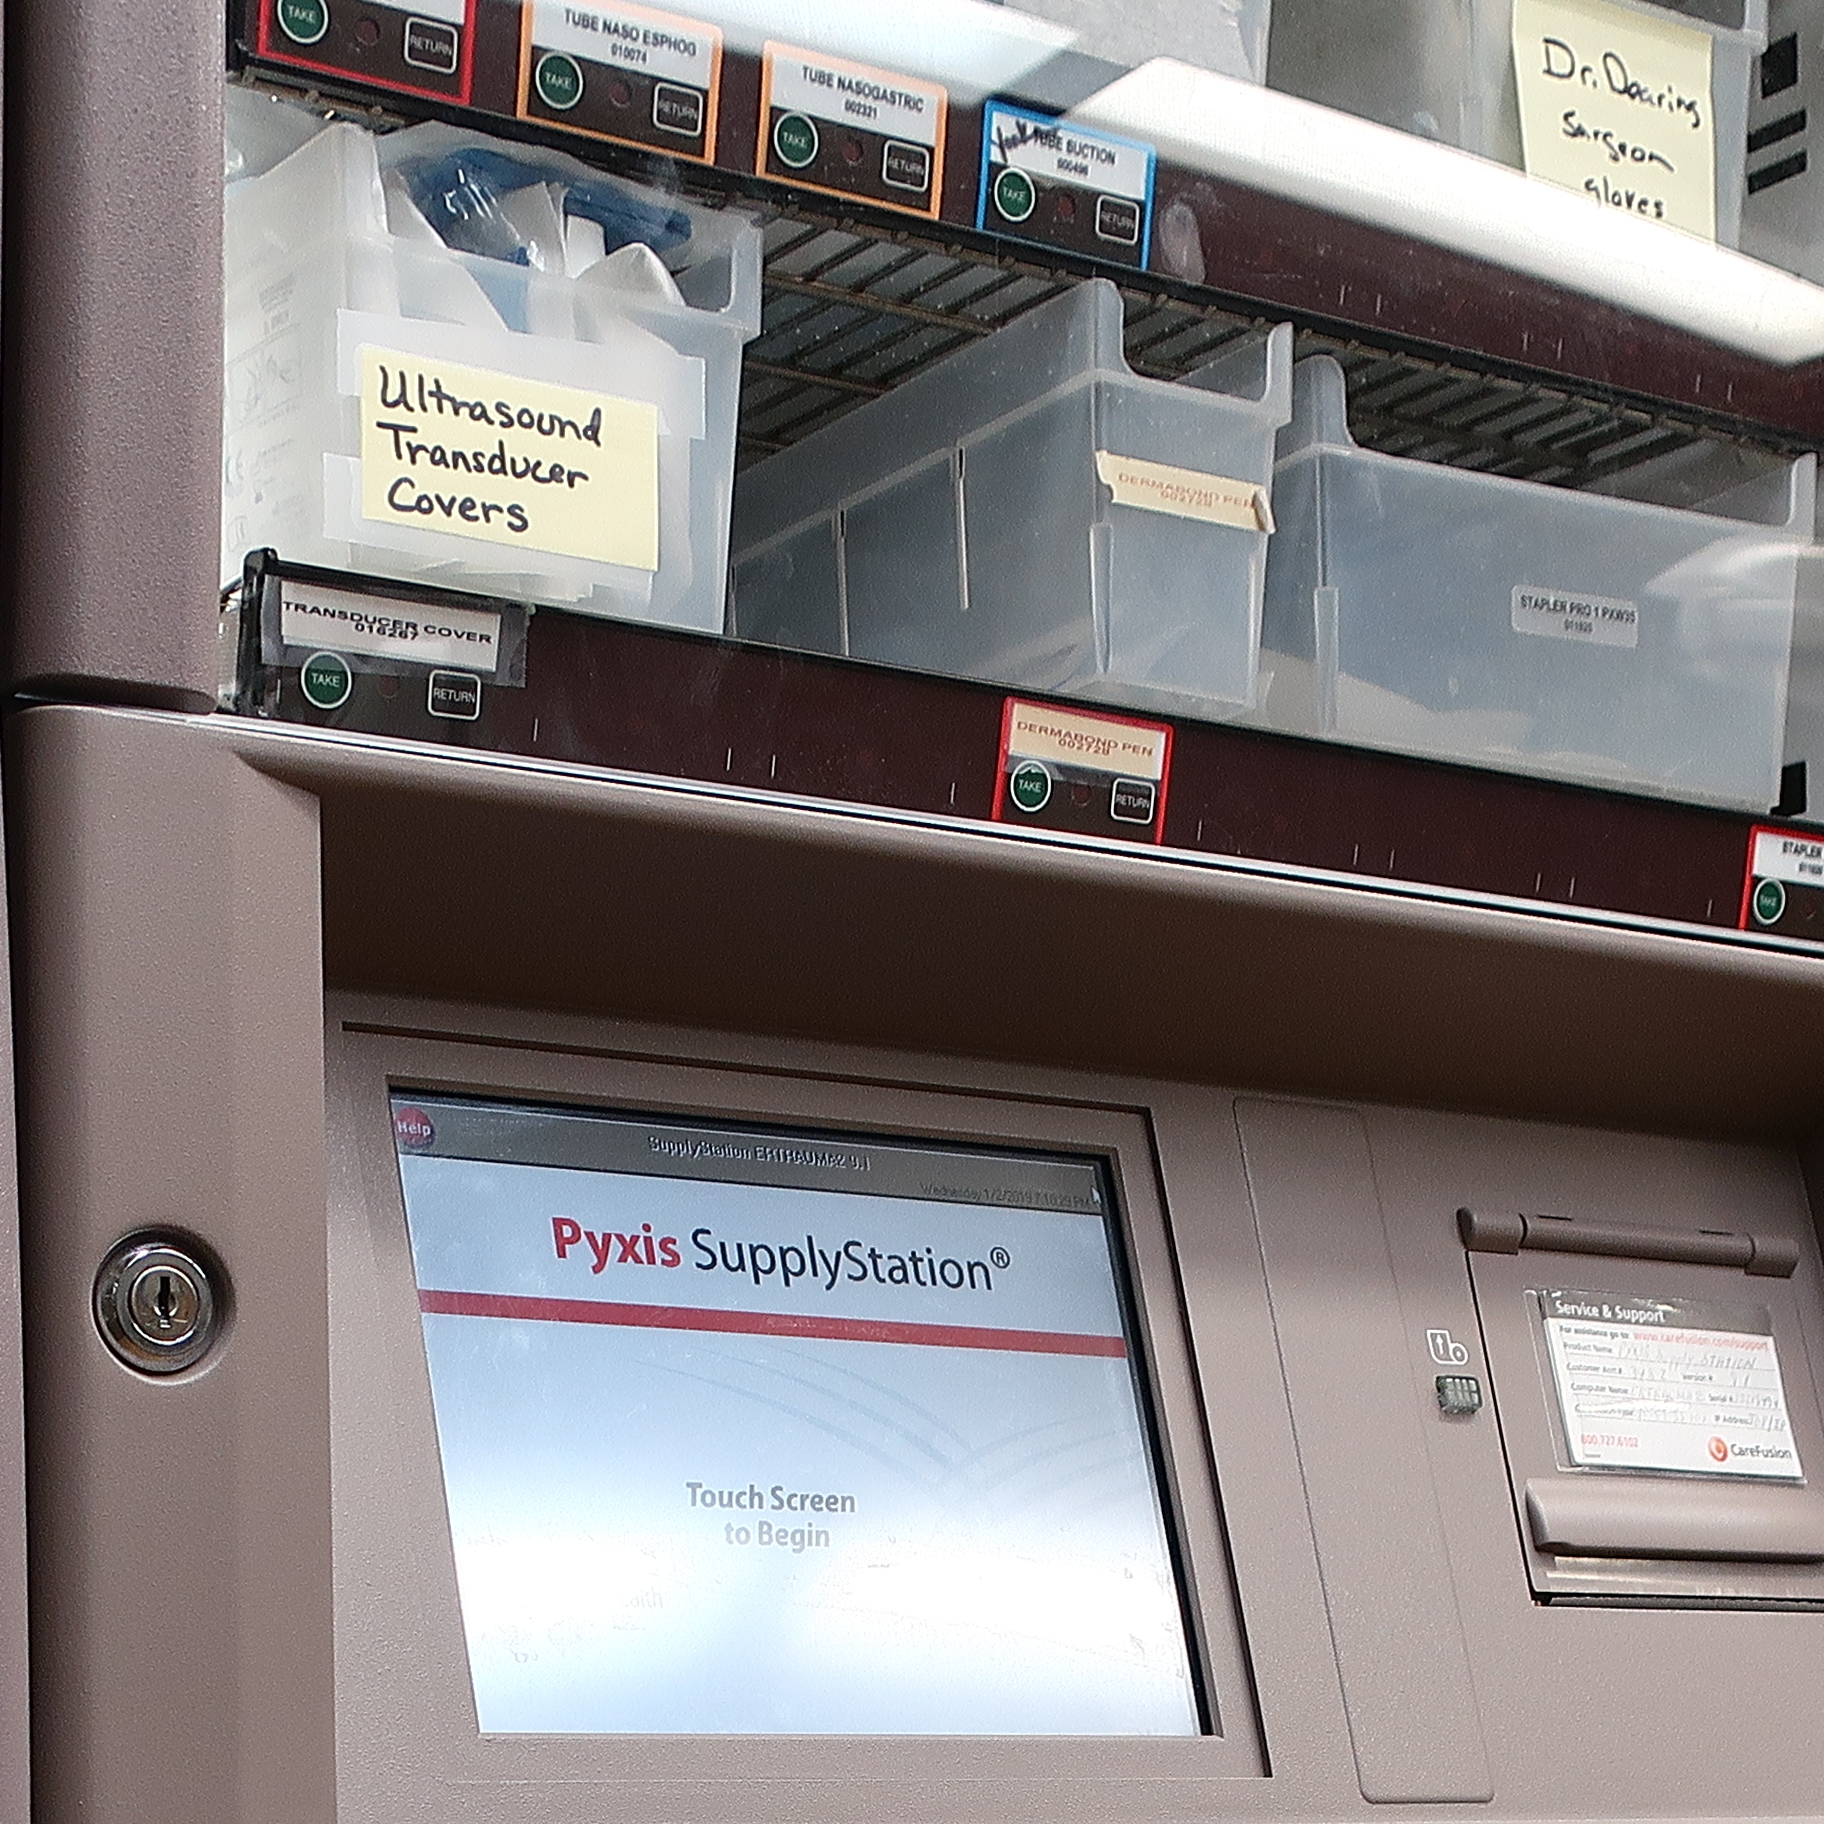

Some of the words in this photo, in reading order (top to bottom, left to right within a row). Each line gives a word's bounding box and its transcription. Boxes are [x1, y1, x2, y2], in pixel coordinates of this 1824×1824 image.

[564, 9, 599, 32] TUBE
[602, 19, 639, 43] NASO
[643, 29, 697, 57] ESPHOG
[1543, 37, 1598, 89] Dr.
[543, 71, 573, 91] TAKE
[801, 65, 834, 89] TUBE
[836, 76, 924, 113] NASOGASTRIC
[1066, 136, 1116, 165] SUCTION
[1563, 110, 1674, 172] Surgeon
[1585, 176, 1664, 219] gloves
[378, 364, 602, 448] Ultrasound
[376, 422, 589, 489] Transducer
[1118, 473, 1219, 500] DERMABOND
[387, 477, 531, 532] Covers
[1520, 595, 1568, 612] STAPLER
[283, 601, 418, 631] TRANSDUCER
[423, 624, 493, 645] COVER
[311, 672, 340, 687] TAKE
[433, 687, 476, 703] RETURN
[1017, 721, 1118, 748] DERMABOND
[1122, 744, 1153, 756] PEN
[1782, 841, 1822, 858] STAPLER
[397, 1120, 432, 1141] Help
[648, 1135, 753, 1161] SupplyStation
[551, 1215, 682, 1274] Pyxis
[1555, 1300, 1600, 1317] Service
[1602, 1303, 1612, 1318] &
[1615, 1304, 1666, 1323] Support
[1731, 1443, 1792, 1459] CareFusion
[685, 1481, 765, 1512] Touch
[769, 1485, 857, 1514] Screen
[723, 1521, 752, 1546] to
[756, 1521, 831, 1554] Begin
